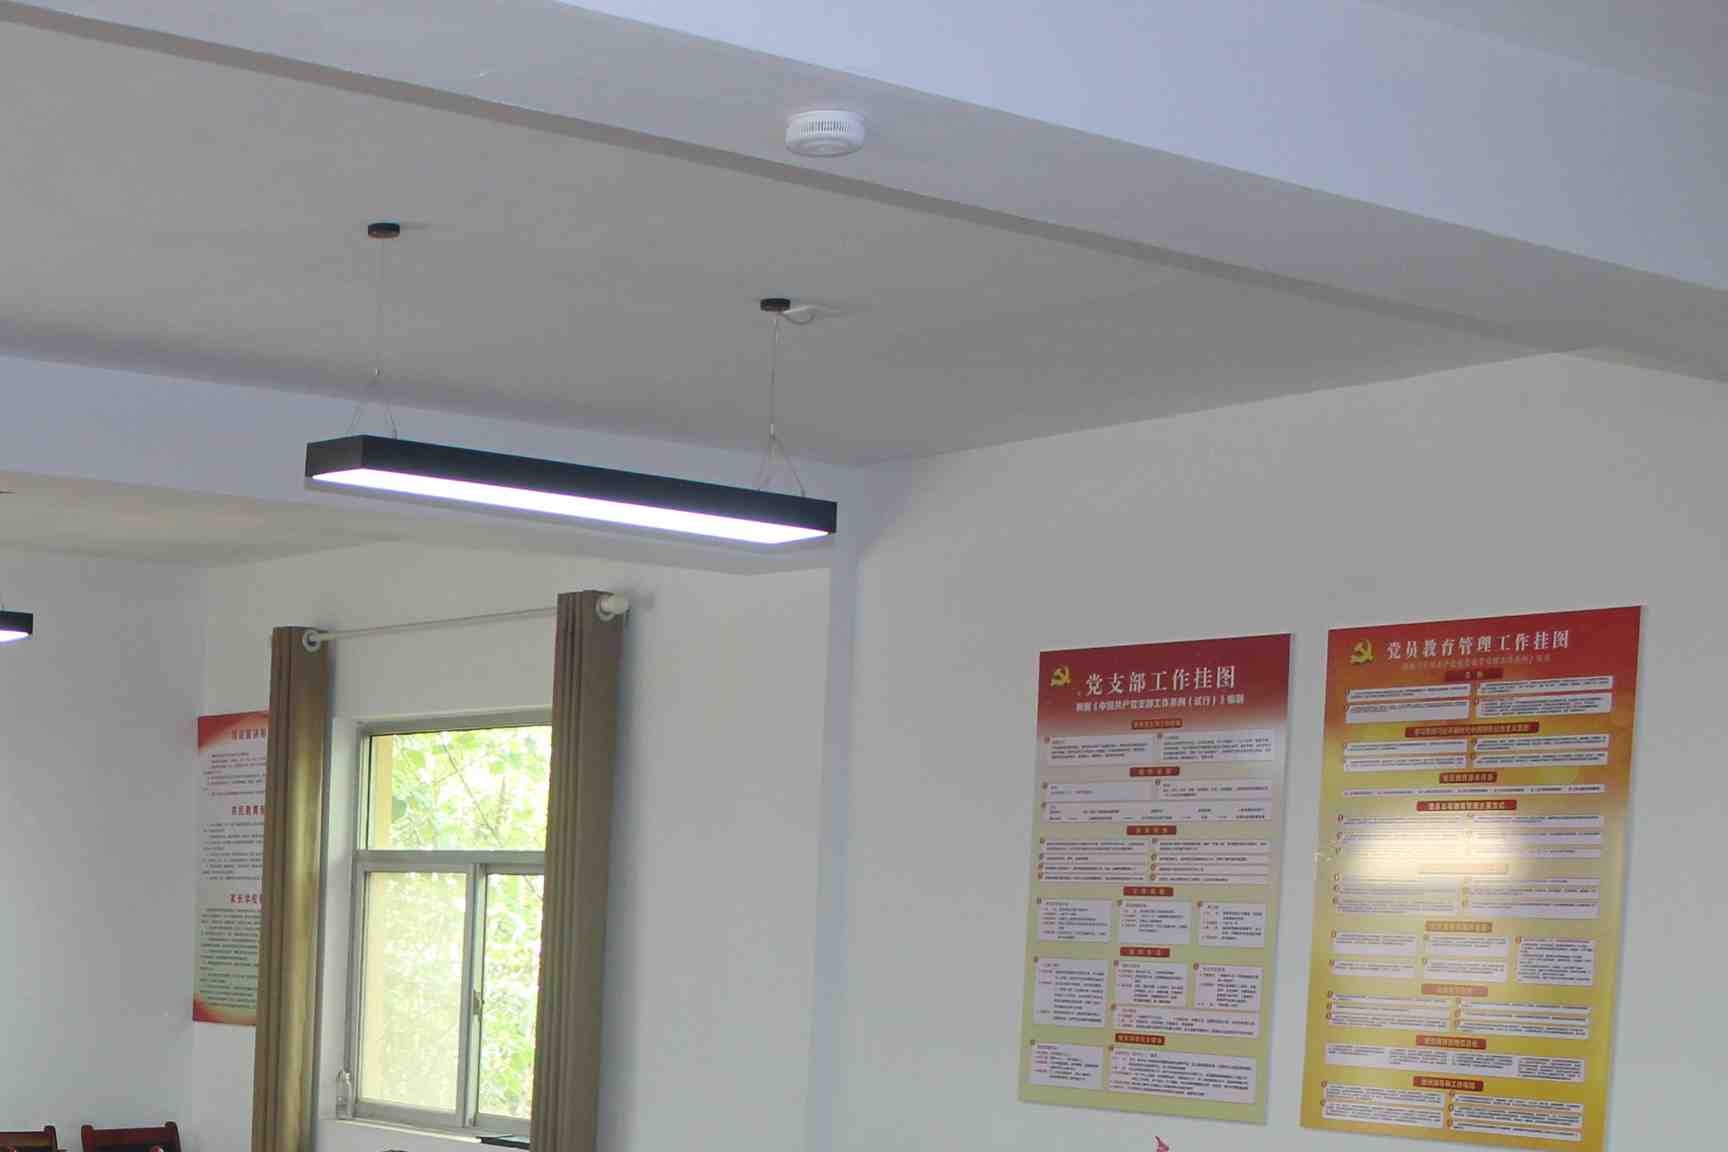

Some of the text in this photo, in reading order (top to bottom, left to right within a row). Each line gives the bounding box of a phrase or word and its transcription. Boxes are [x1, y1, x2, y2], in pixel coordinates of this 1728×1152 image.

[1386, 630, 1569, 660] 党员教育管理工作挂图
[1085, 665, 1236, 697] 党支部工作挂图
